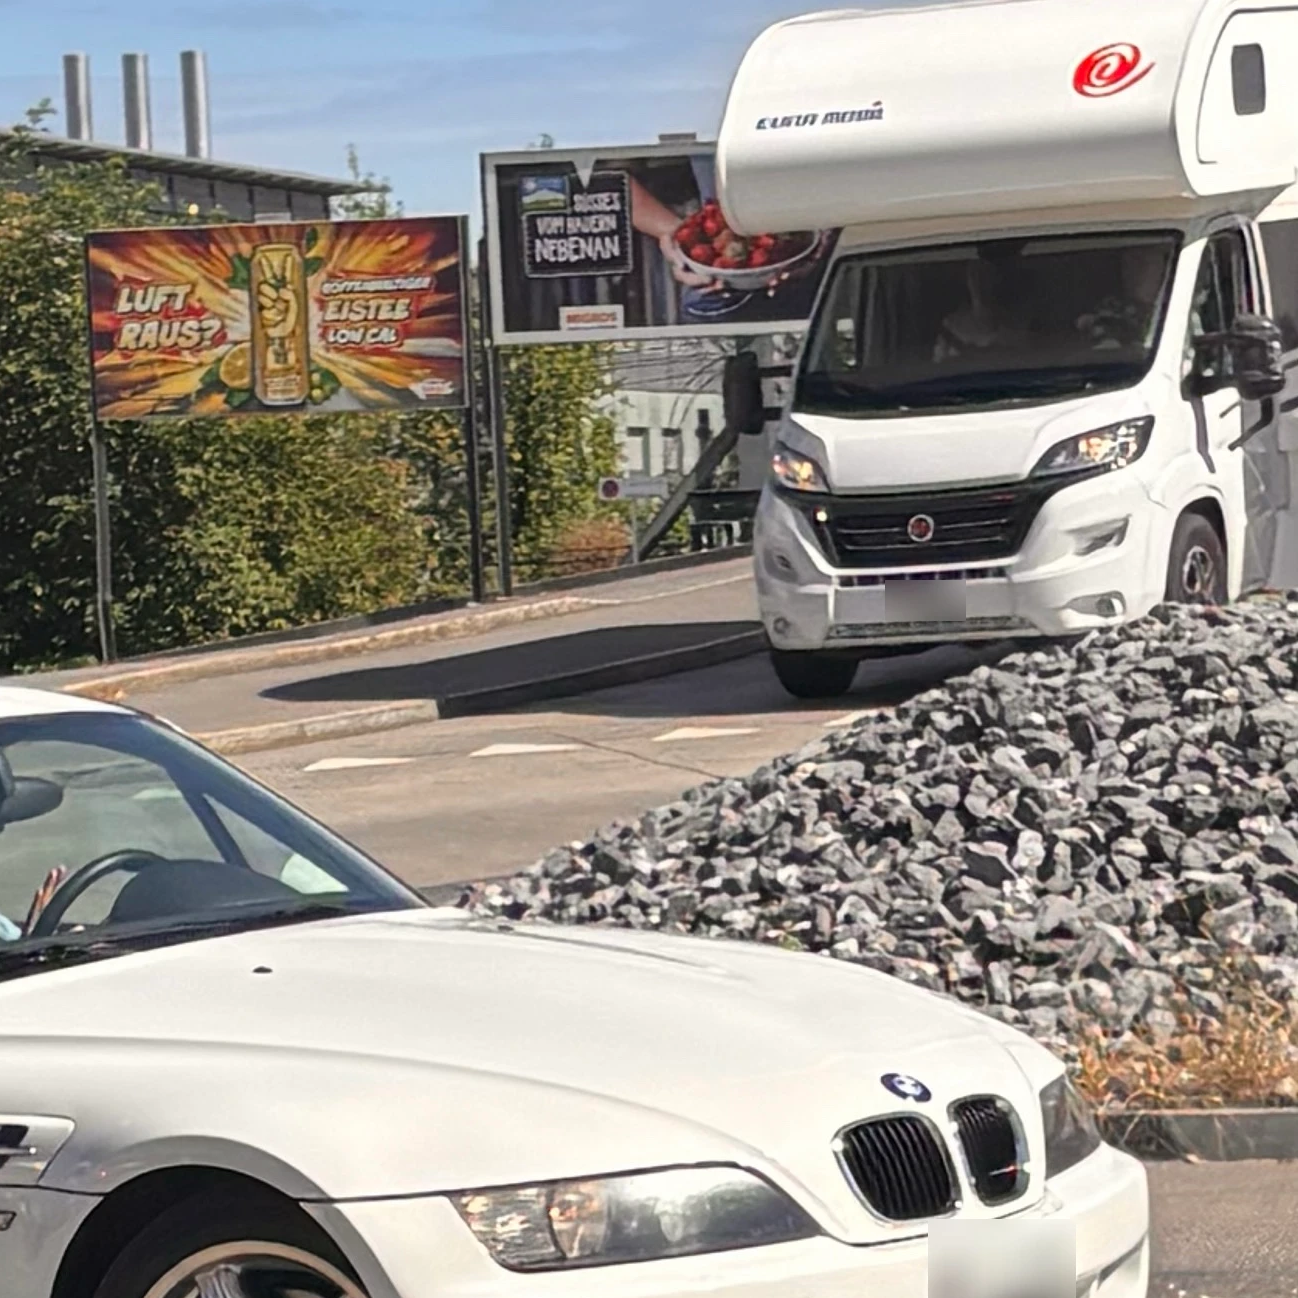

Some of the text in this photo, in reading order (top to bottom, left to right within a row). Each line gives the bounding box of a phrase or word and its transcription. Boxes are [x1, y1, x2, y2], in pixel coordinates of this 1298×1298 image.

[534, 234, 620, 263] NEBENAN
[117, 283, 192, 314] LUFT
[324, 298, 411, 321] EISTEE
[118, 318, 222, 350] RAUS?
[327, 327, 397, 344] LOW CAL
